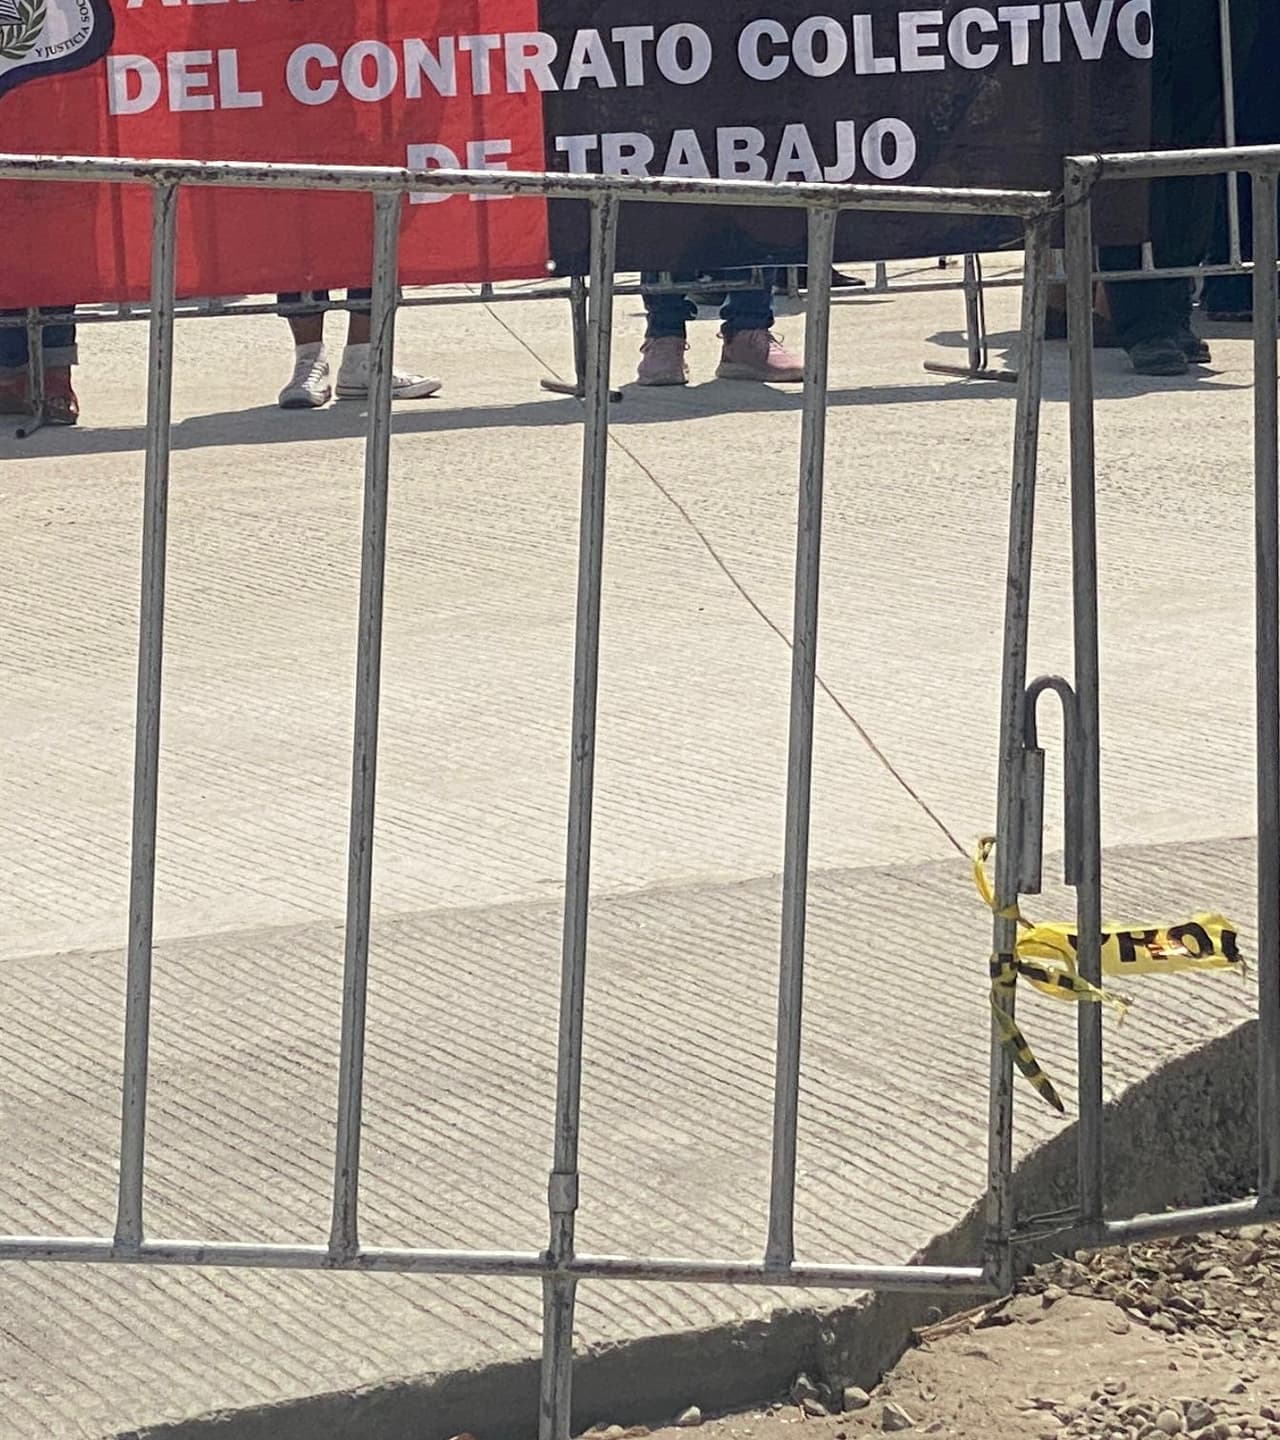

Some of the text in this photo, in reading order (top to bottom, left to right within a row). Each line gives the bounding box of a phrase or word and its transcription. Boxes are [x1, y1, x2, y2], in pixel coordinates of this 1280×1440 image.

[35, 47, 43, 57] Y
[44, 26, 90, 58] JUSTICIA
[107, 47, 264, 116] DEL
[286, 22, 713, 106] CONTRATO
[406, 117, 917, 205] DE TRABAJO
